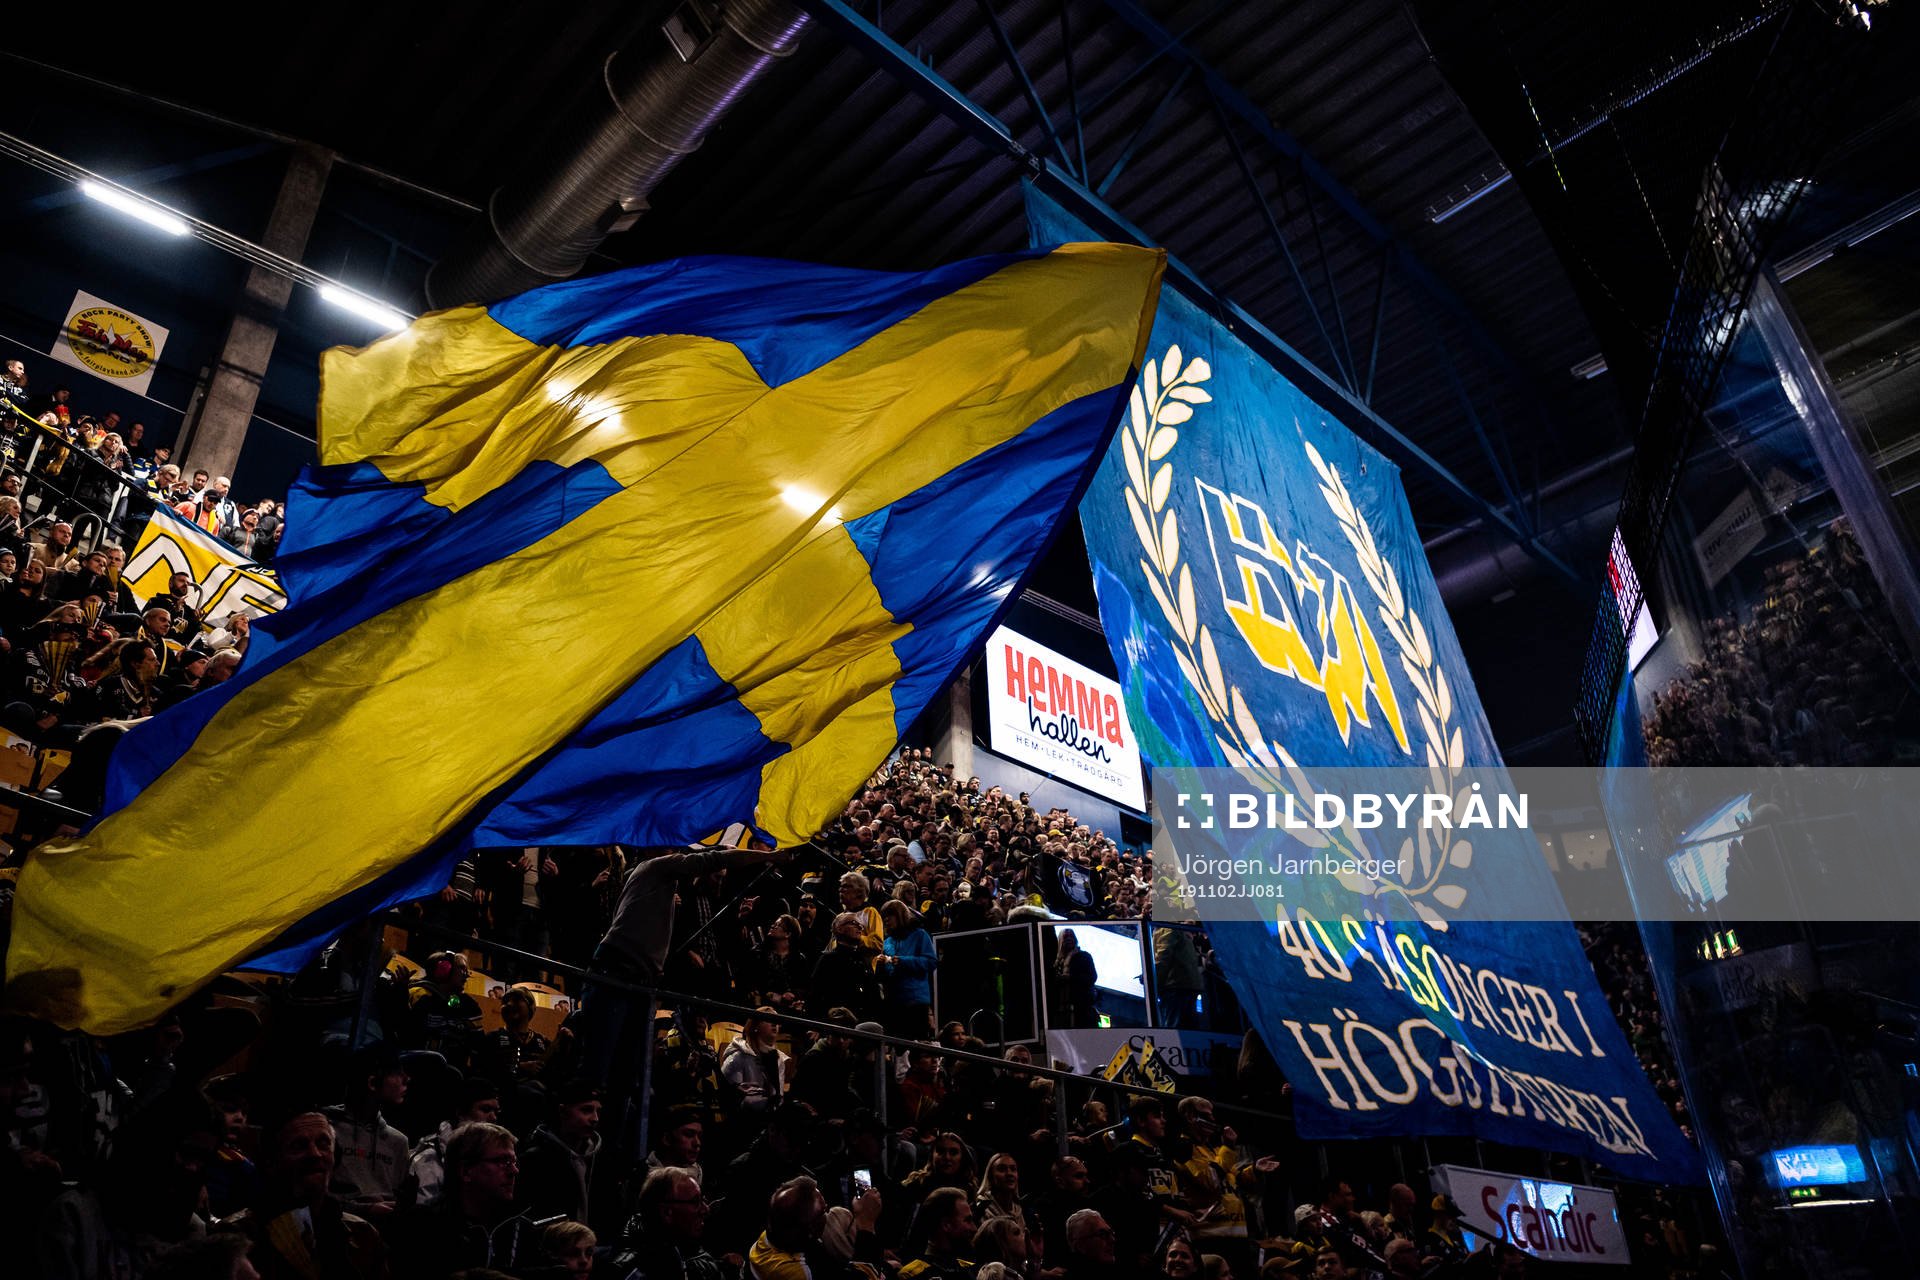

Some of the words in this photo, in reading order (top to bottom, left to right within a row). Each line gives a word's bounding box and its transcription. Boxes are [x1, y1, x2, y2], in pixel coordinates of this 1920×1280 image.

[81, 309, 105, 320] ROCK
[107, 310, 136, 325] PARTY
[135, 325, 152, 349] SHOW
[1028, 695, 1111, 764] hallen
[1276, 903, 1352, 982] 40
[1340, 908, 1582, 1057] SÄSONGER
[1563, 990, 1606, 1057] I
[1481, 1185, 1606, 1255] Scandic
